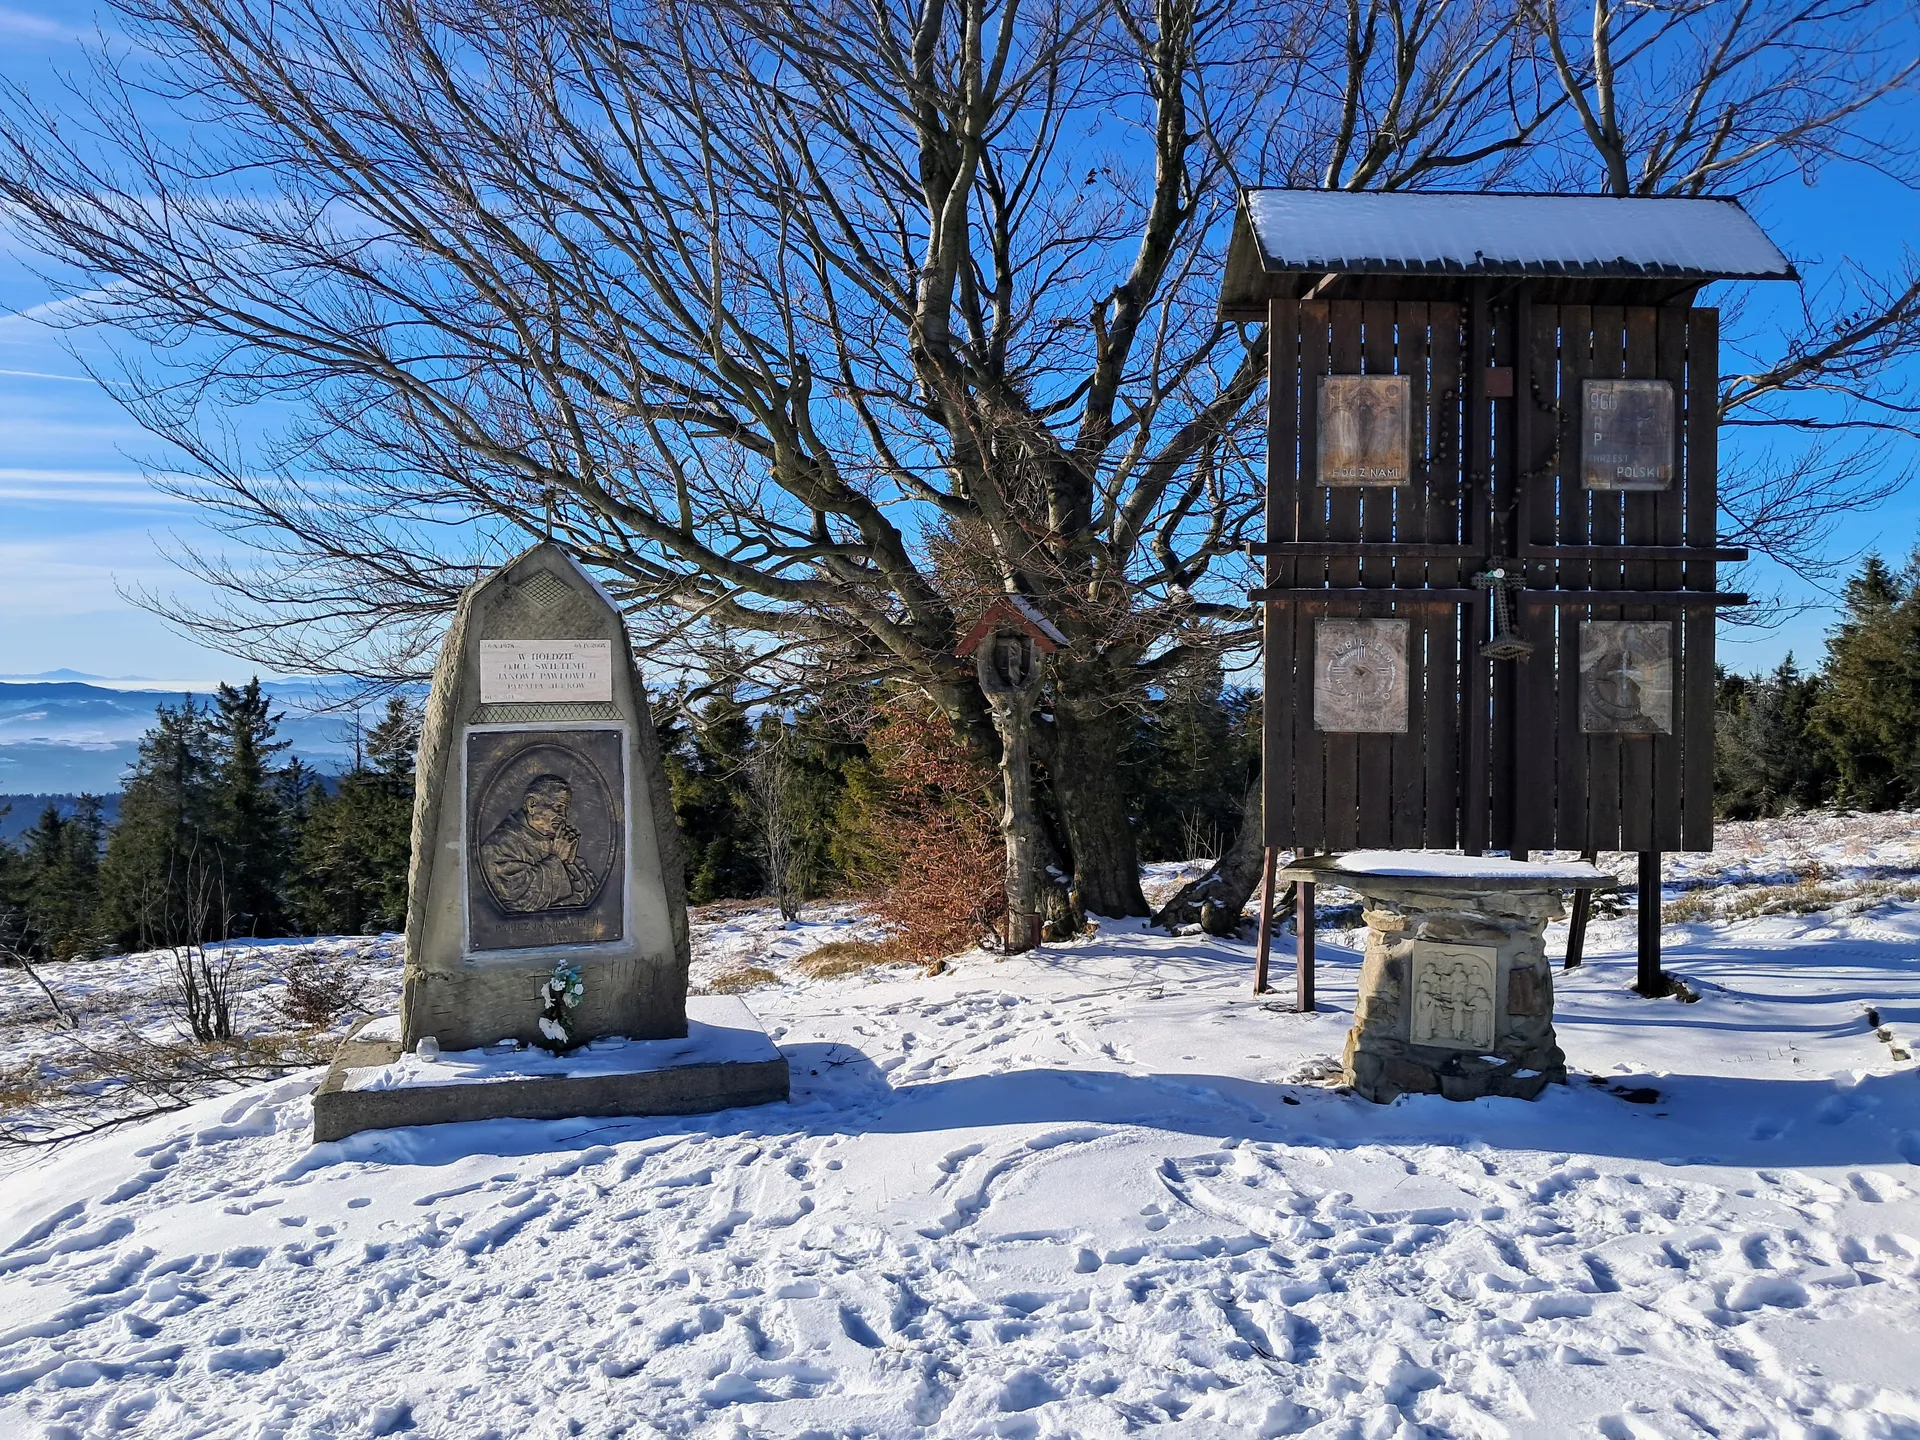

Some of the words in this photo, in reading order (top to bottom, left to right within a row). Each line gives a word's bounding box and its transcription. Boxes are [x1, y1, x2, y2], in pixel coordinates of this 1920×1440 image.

[1594, 416, 1603, 430] R
[1593, 432, 1602, 447] P
[1589, 454, 1629, 464] HRZEST
[1359, 467, 1366, 477] Z
[1370, 467, 1398, 477] NAMI
[1616, 466, 1660, 478] POLSKI
